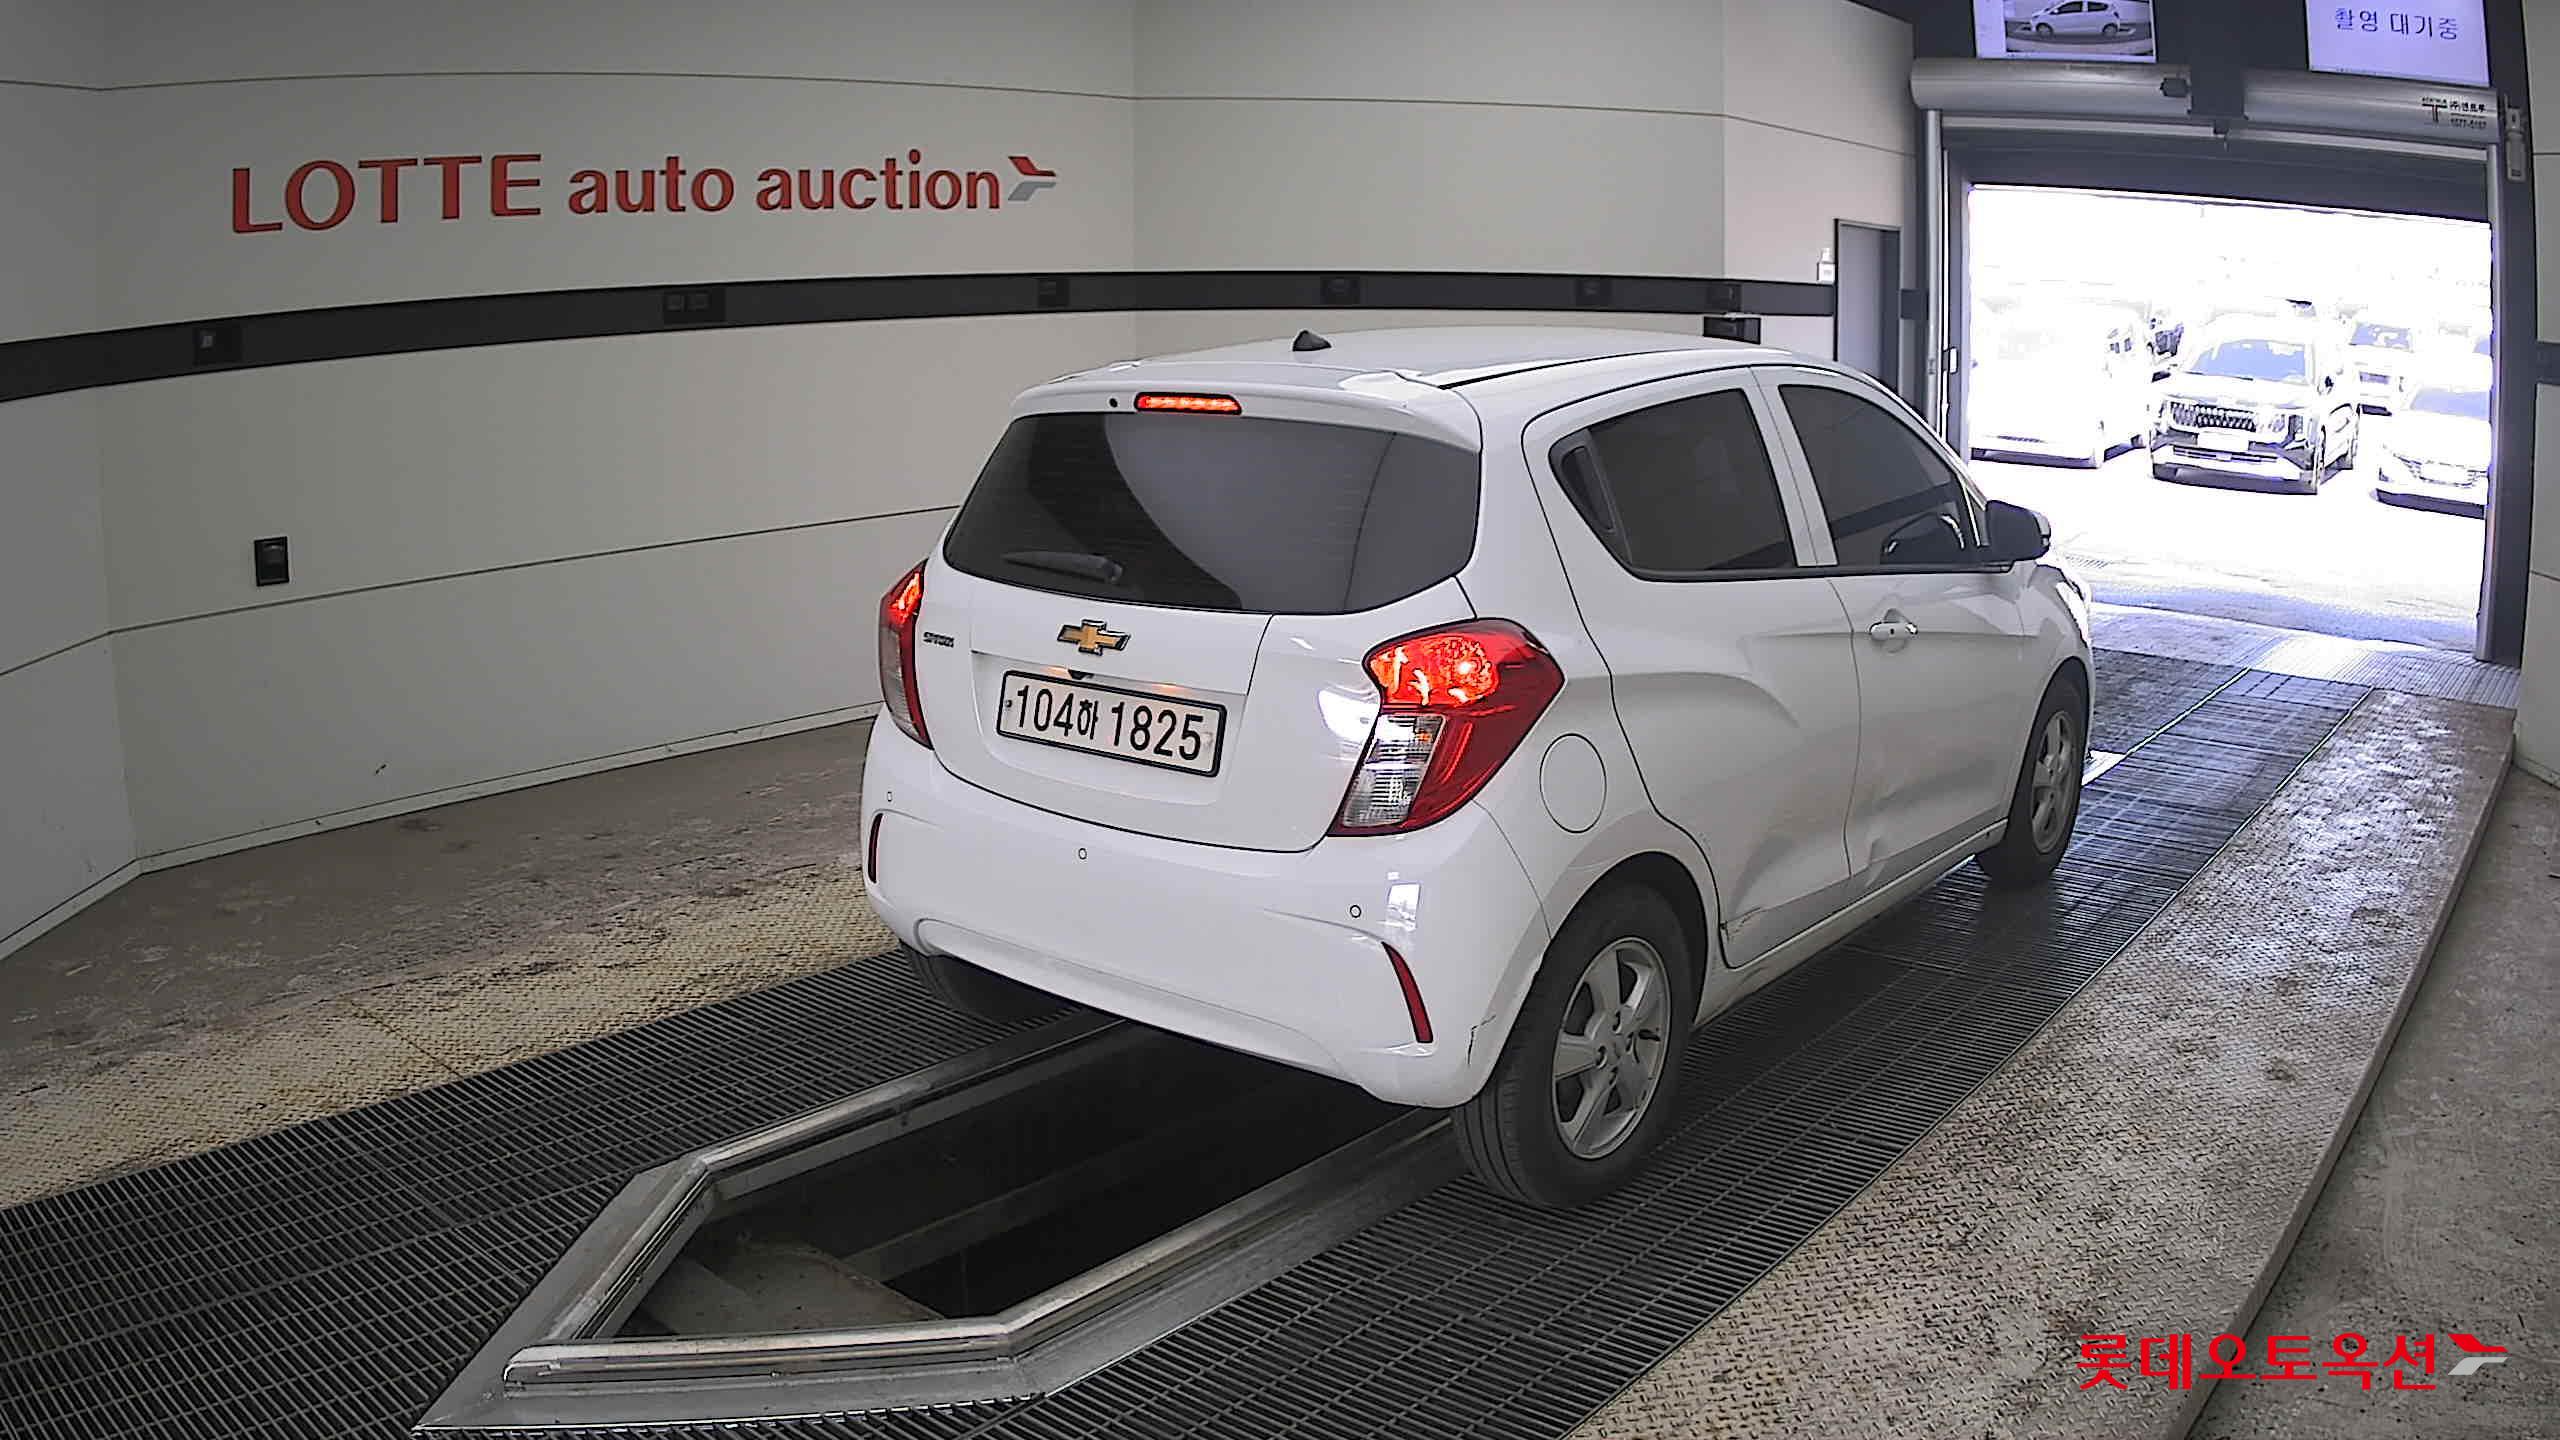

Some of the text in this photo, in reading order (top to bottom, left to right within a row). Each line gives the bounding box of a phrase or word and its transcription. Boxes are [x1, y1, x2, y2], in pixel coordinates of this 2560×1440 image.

[2335, 8, 2379, 33] 촬영
[232, 149, 1000, 234] LOTTE auto auction
[1017, 685, 1204, 761] 104하 1825
